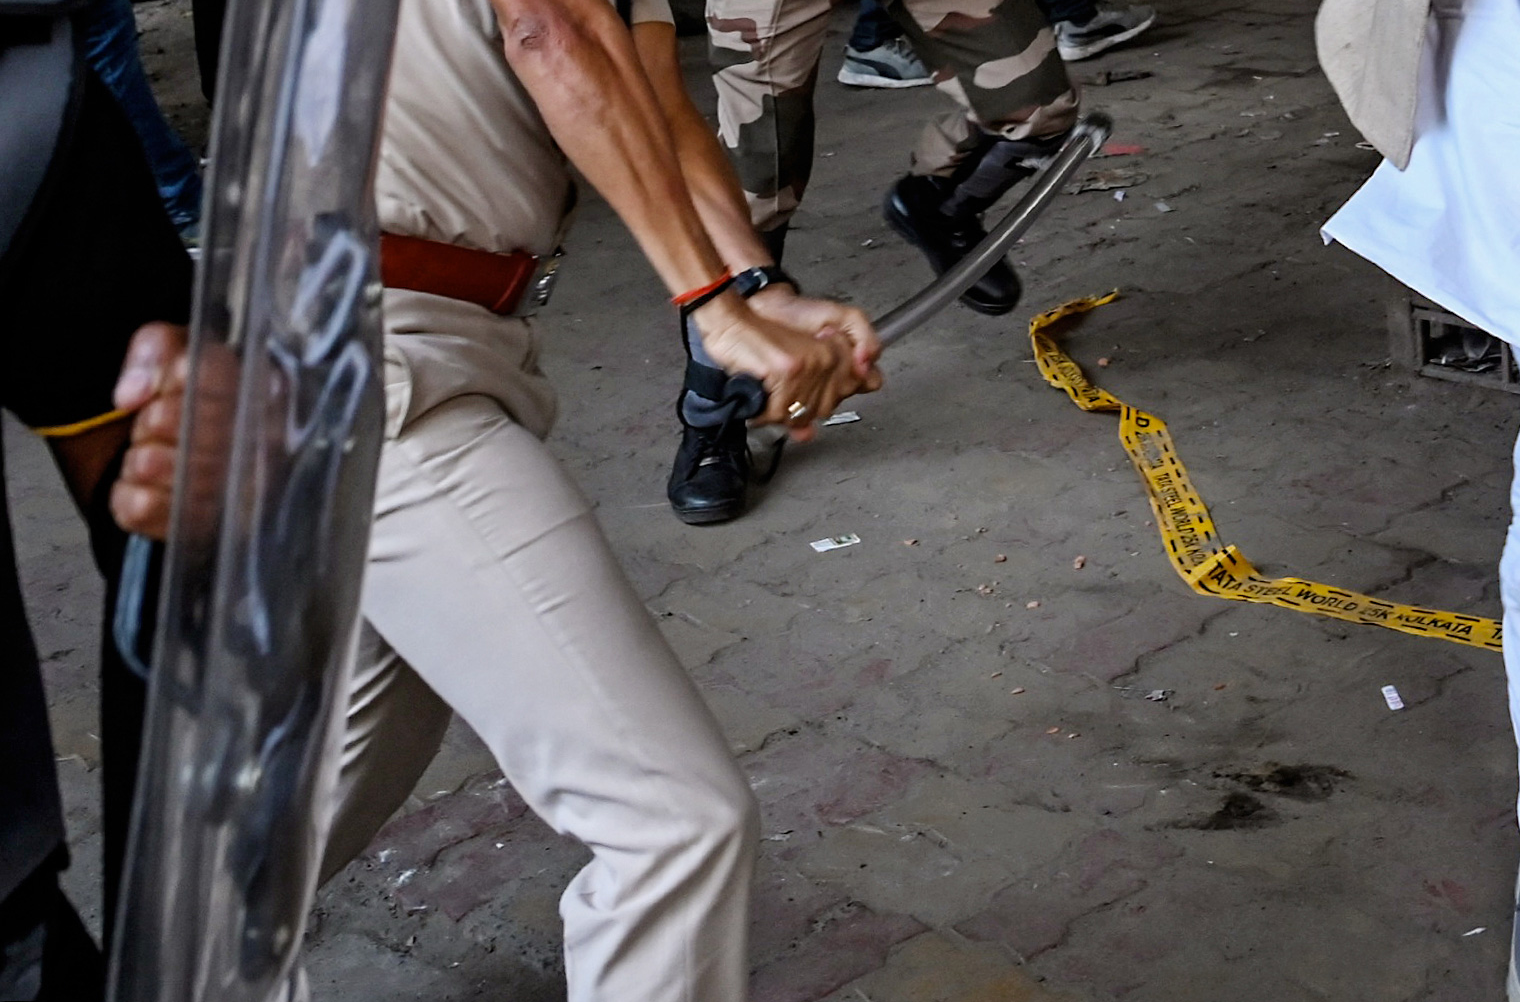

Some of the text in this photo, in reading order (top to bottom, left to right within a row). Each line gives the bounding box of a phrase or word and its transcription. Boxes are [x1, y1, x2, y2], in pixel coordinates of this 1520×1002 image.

[1207, 559, 1243, 591] TATA
[1243, 583, 1293, 597] STEEL
[1296, 588, 1358, 612] WORLD
[1396, 613, 1474, 636] KOLKATA
